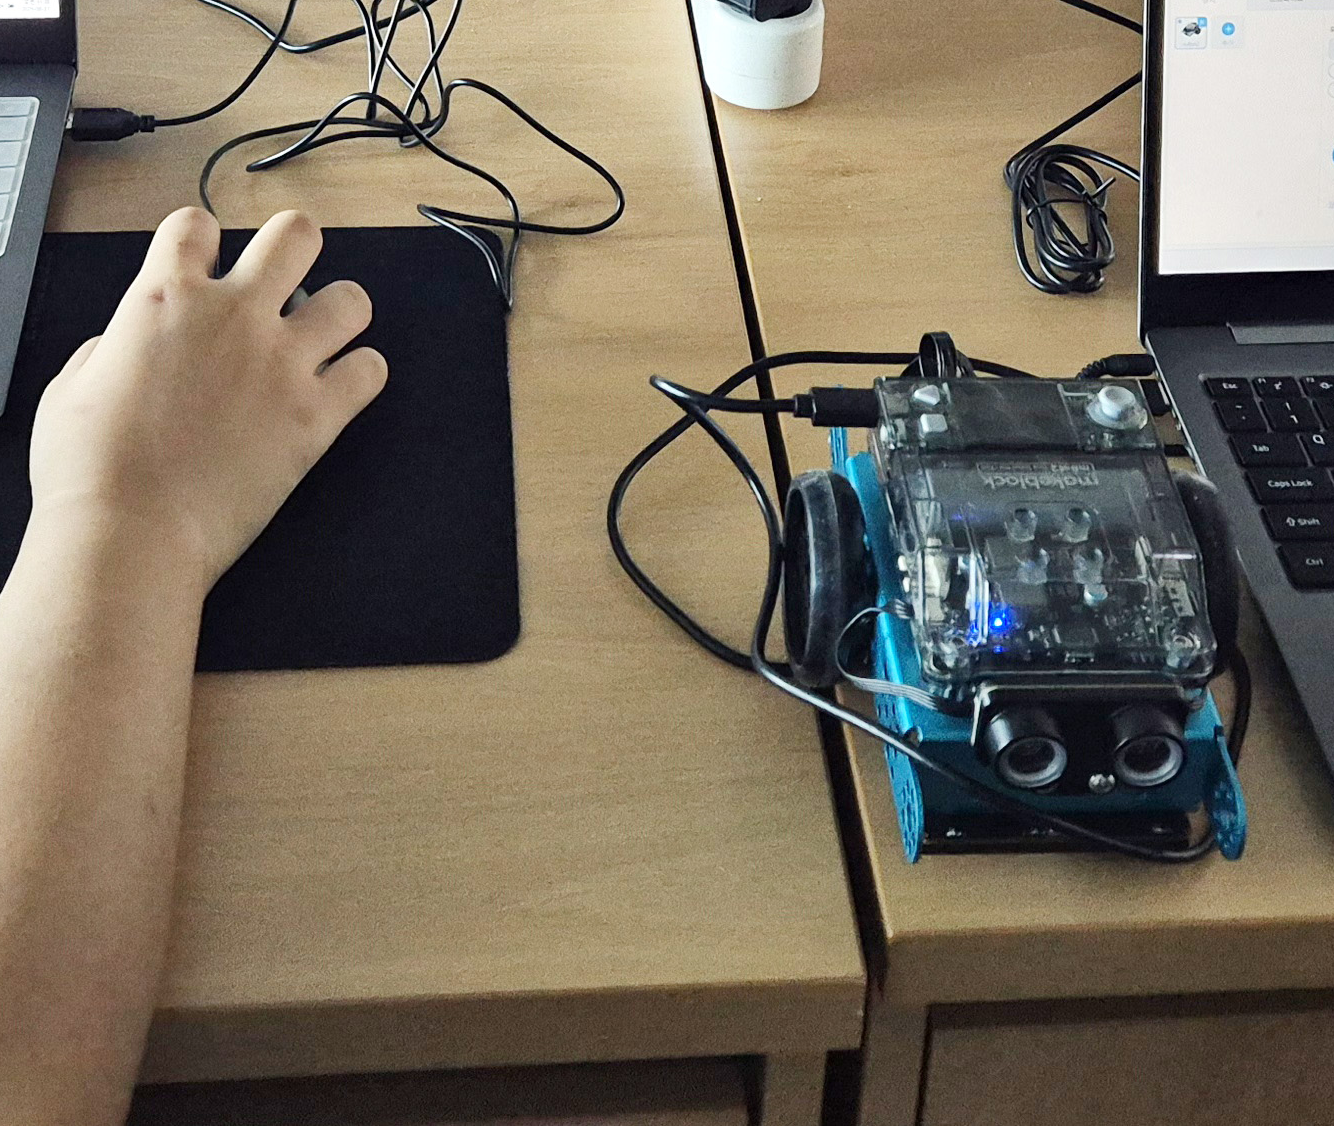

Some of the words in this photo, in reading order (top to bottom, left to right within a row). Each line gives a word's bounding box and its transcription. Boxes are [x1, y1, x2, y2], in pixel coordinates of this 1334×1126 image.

[981, 474, 1099, 490] makeblock
[1267, 478, 1291, 489] Caps
[1292, 478, 1314, 488] Lock
[1297, 517, 1321, 526] Shift
[1305, 557, 1324, 567] Ctrl
